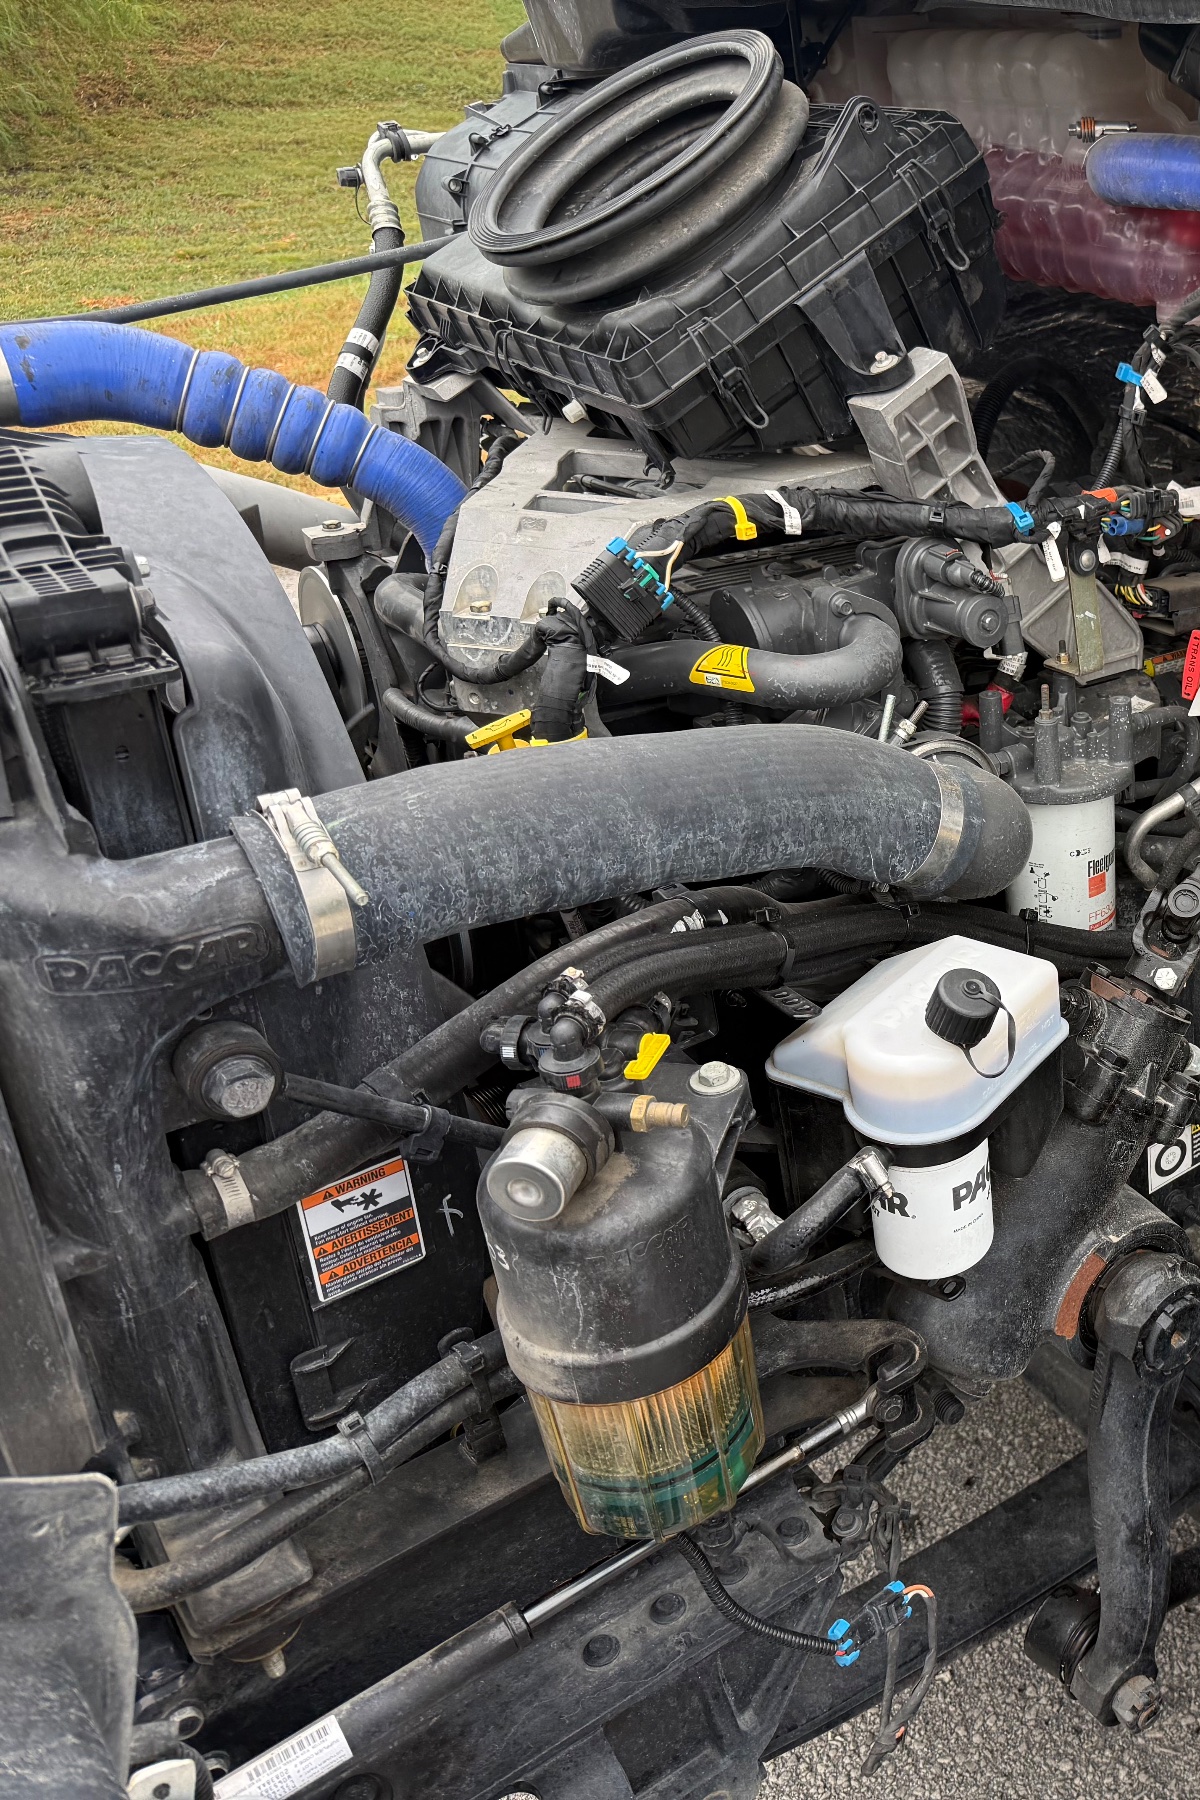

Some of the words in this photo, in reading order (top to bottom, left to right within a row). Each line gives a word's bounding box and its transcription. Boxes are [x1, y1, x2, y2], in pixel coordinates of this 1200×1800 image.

[1188, 643, 1199, 673] TRANS
[1185, 676, 1193, 692] OIL
[44, 927, 268, 990] PACCAR
[1041, 1014, 1055, 1033] HOT
[335, 1168, 386, 1193] WARNING
[314, 1232, 327, 1242] Keep
[328, 1227, 340, 1237] clear
[347, 1218, 364, 1230] engine
[315, 1238, 325, 1246] Fan
[326, 1233, 337, 1245] may
[338, 1228, 349, 1238] start
[350, 1221, 367, 1232] without
[368, 1212, 390, 1226] warning.
[331, 1209, 412, 1249] AVERTISSEMENT
[319, 1252, 338, 1263] Restez
[342, 1236, 414, 1274] ADVERTENCIA
